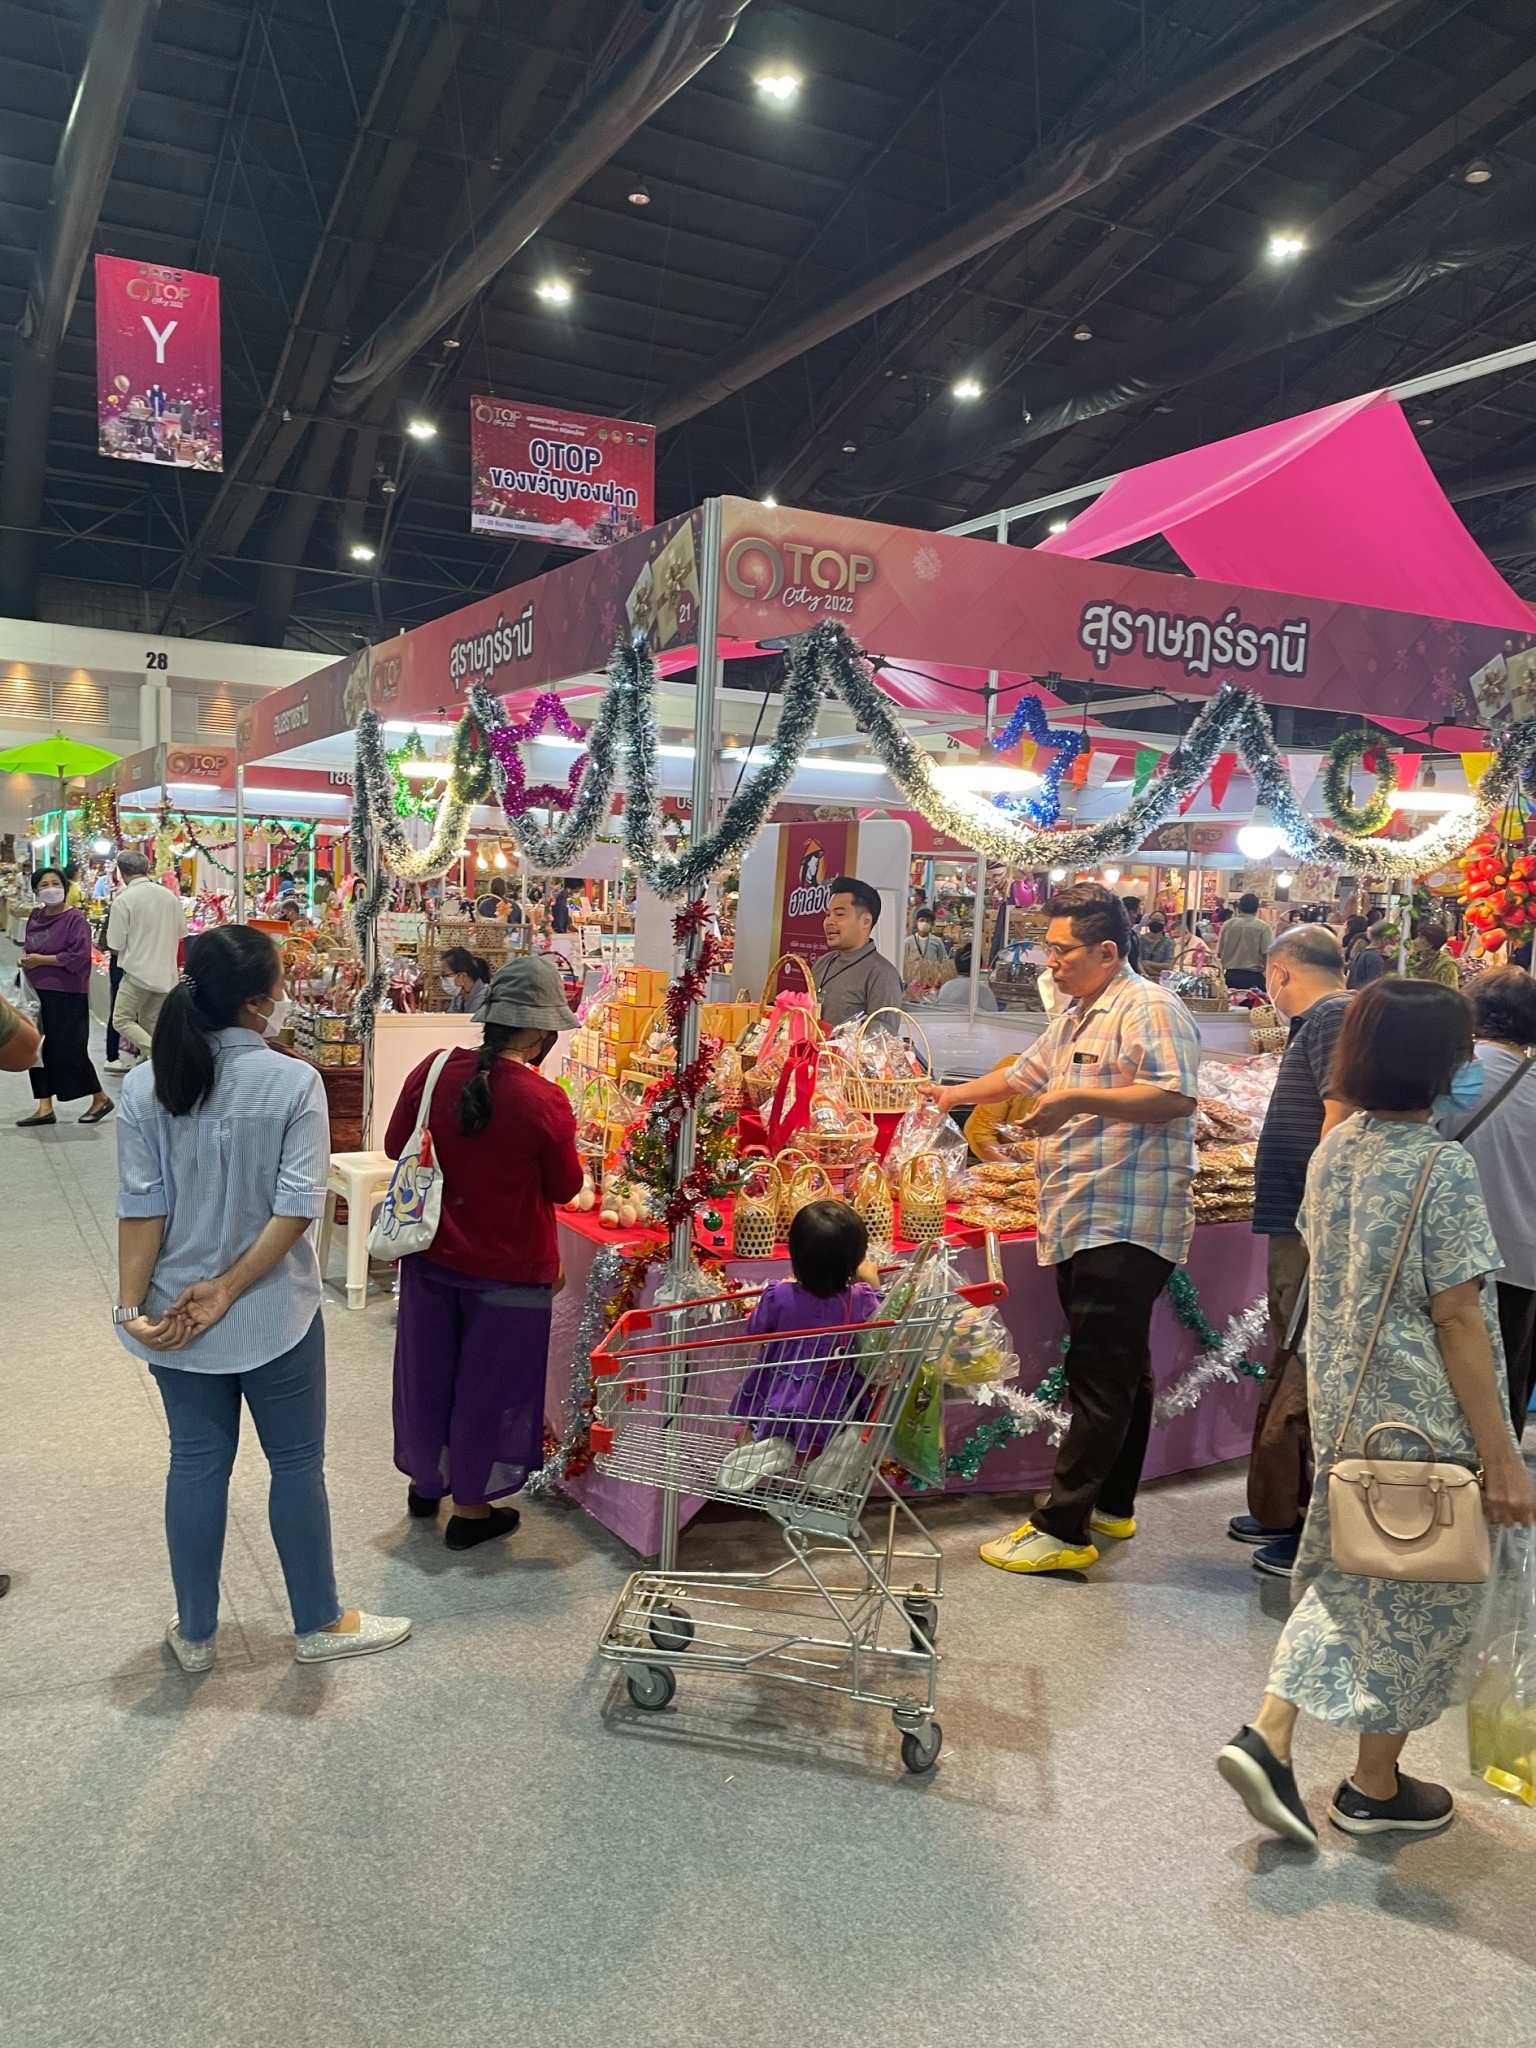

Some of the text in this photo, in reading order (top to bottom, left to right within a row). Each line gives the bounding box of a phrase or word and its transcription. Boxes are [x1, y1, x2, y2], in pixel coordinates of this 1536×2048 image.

[126, 278, 191, 302] OTOP
[141, 315, 178, 364] Y
[475, 404, 522, 424] OTOP
[529, 438, 602, 475] OTOP
[490, 467, 638, 508] ของขวัญของฝาก
[725, 536, 875, 601] OTOP
[679, 602, 691, 624] 21
[782, 586, 854, 613] City 2022
[450, 604, 533, 690] สุราษฎร์ธานี
[1081, 605, 1308, 673] สุราษฎร์ธานี
[146, 651, 168, 670] 28
[168, 753, 227, 774] OTOP
